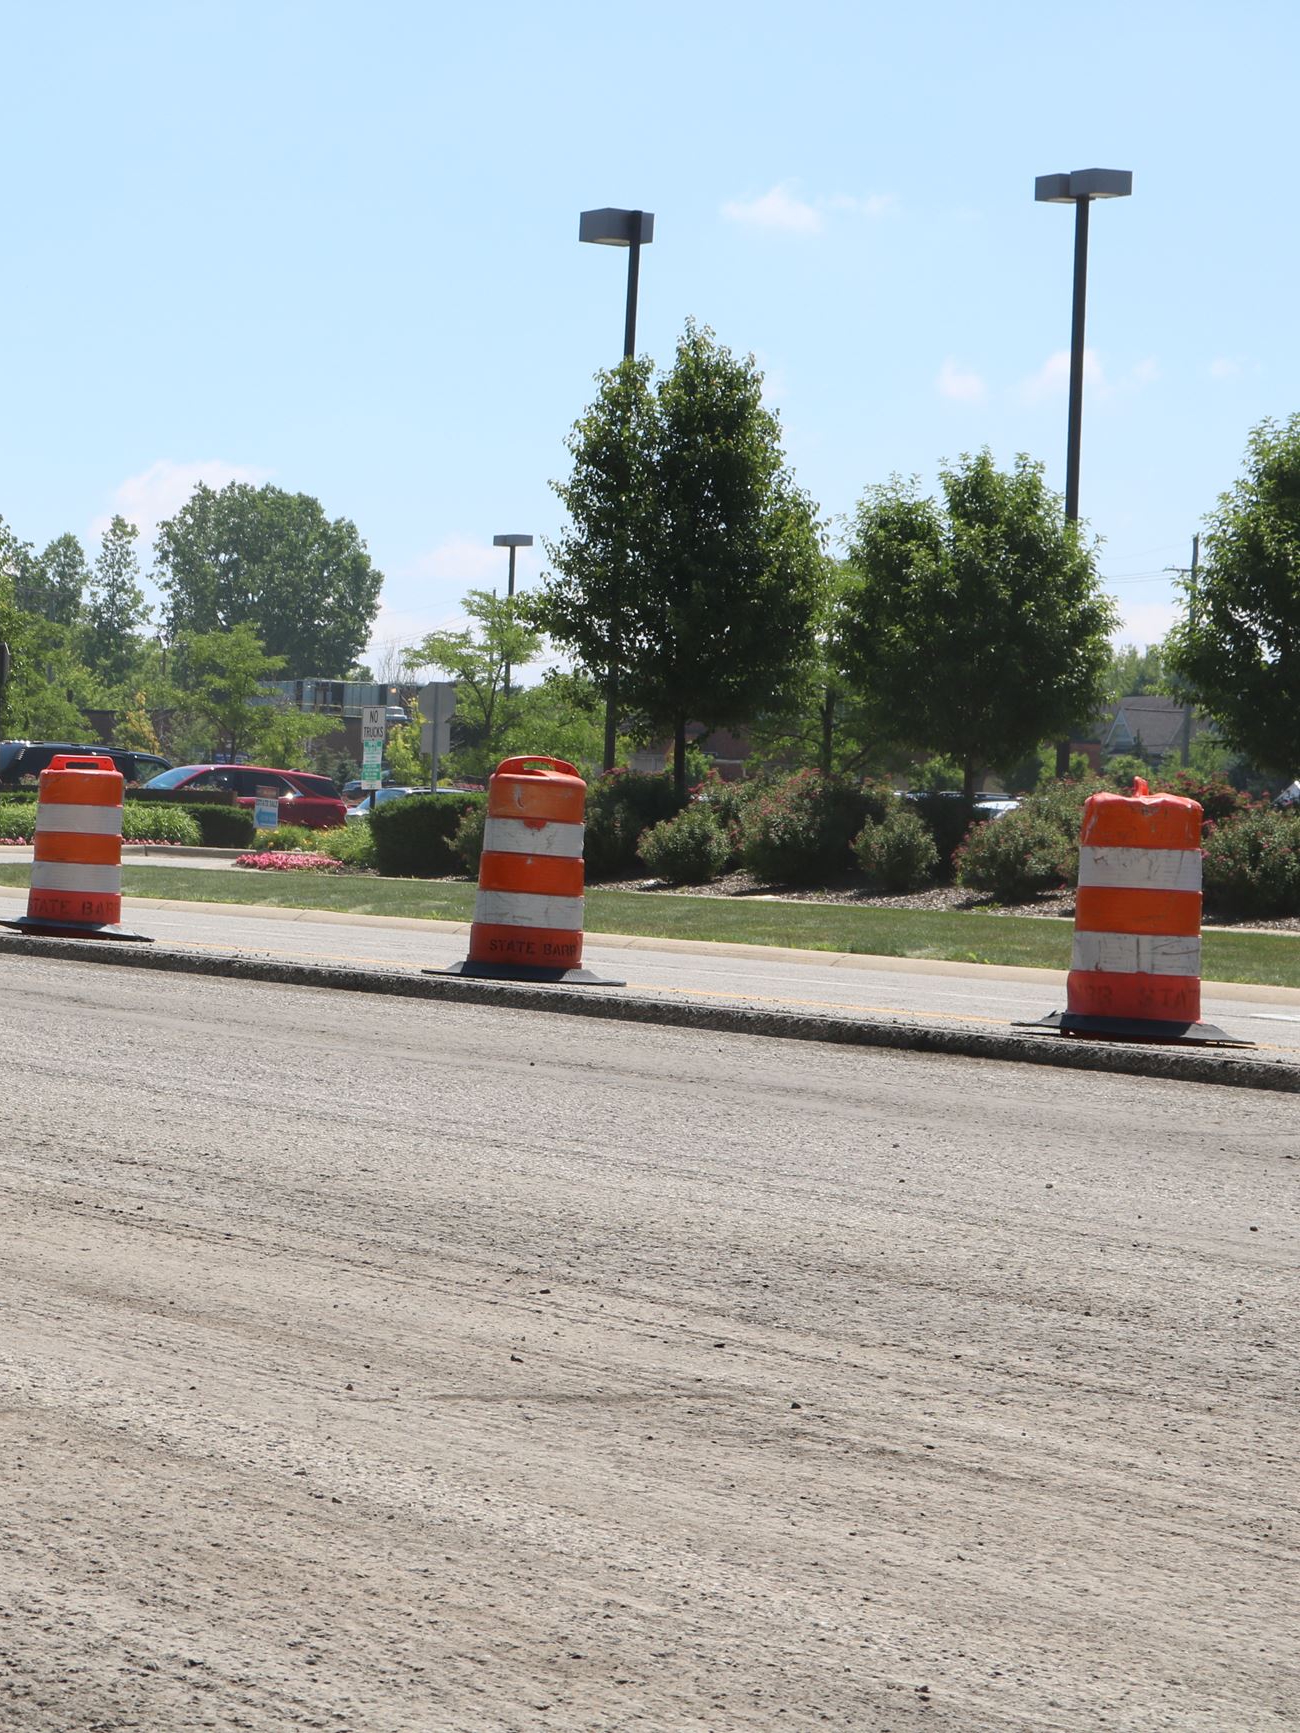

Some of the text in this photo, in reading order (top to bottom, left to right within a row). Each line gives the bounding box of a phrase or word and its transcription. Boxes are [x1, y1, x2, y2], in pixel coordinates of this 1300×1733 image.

[369, 710, 379, 723] NO
[364, 726, 384, 738] TRUCKS
[489, 938, 535, 955] STATE
